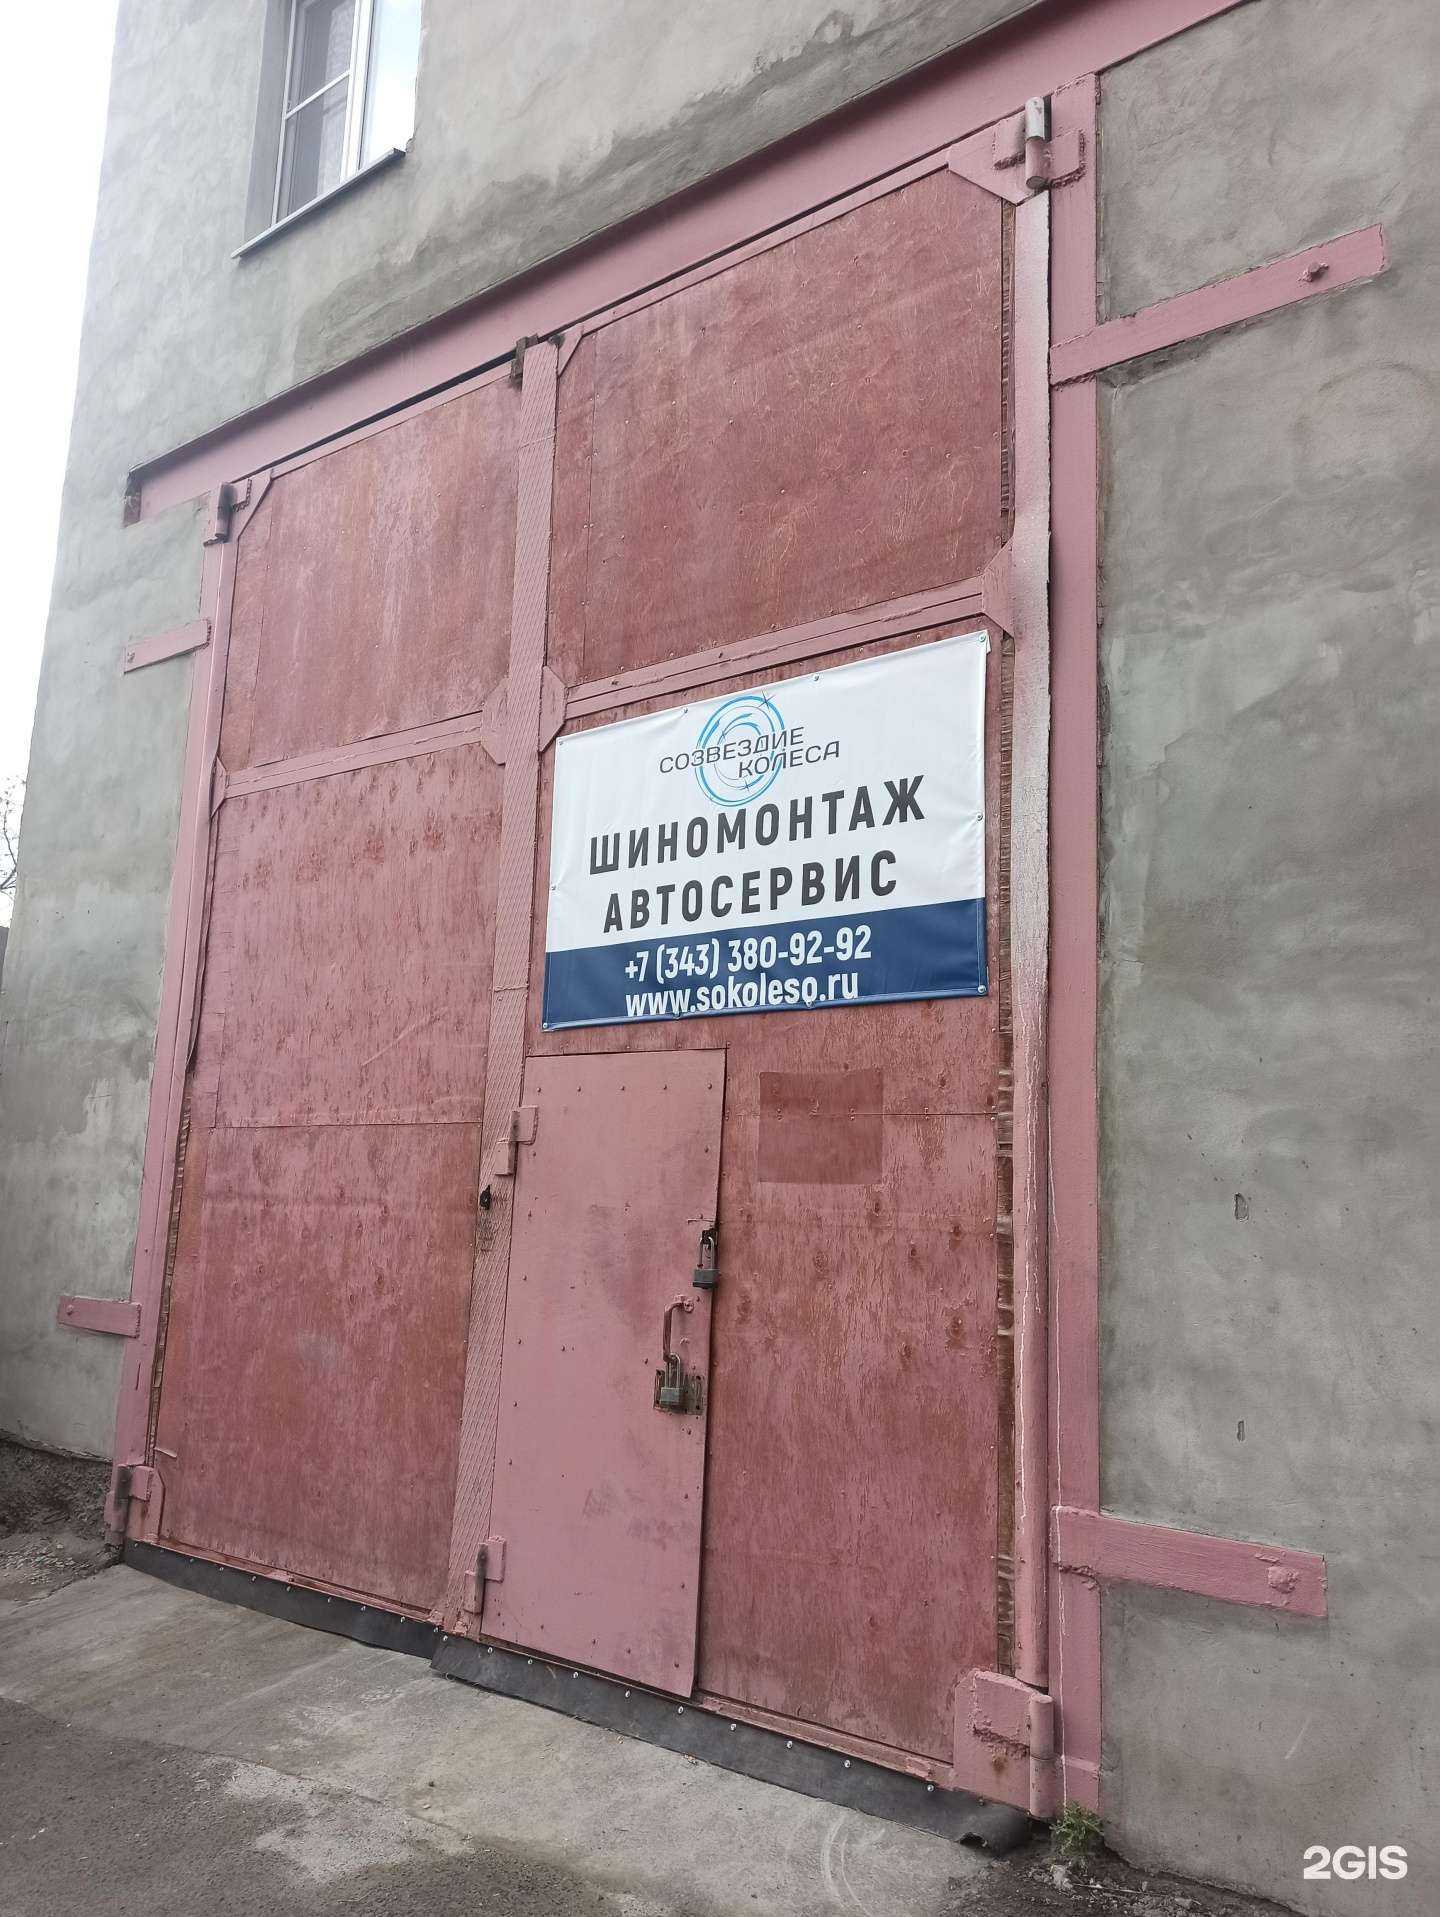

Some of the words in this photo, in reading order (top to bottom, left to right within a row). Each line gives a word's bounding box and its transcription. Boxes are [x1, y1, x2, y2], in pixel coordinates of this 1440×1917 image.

[659, 727, 805, 774] СОЗВЕЗДИЕ
[738, 740, 841, 778] КОЛЕСА
[589, 775, 926, 876] ШИНОМОНТАЖ
[603, 849, 897, 934] АВТОСЕРВИС
[625, 951, 648, 982] +7
[656, 938, 719, 984] (343)
[727, 924, 872, 971] 380-92-92
[625, 971, 859, 1017] www.sokoleso.ru
